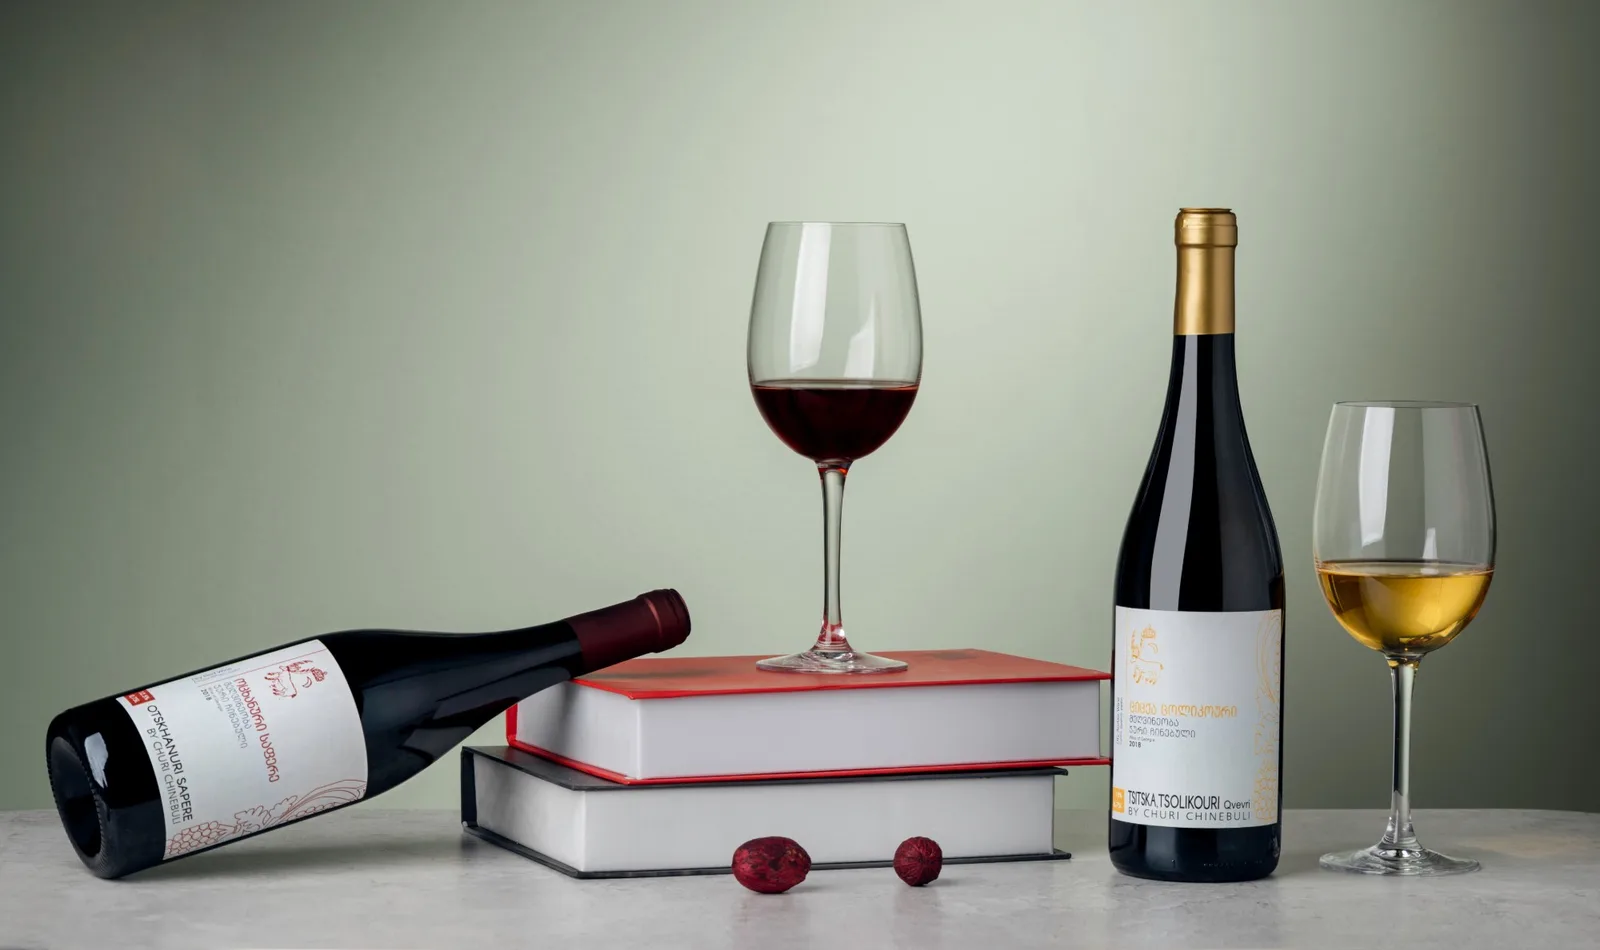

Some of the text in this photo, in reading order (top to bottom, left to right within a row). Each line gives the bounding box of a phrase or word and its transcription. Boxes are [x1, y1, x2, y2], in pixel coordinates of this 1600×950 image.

[1128, 740, 1142, 748] 2018
[147, 704, 193, 822] OTSKHANURI SAPERE
[146, 727, 181, 825] BY CHURI CHINEBULI
[1223, 799, 1251, 810] Qvevri
[1128, 806, 1251, 821] BY CHURI CHINEBULI
